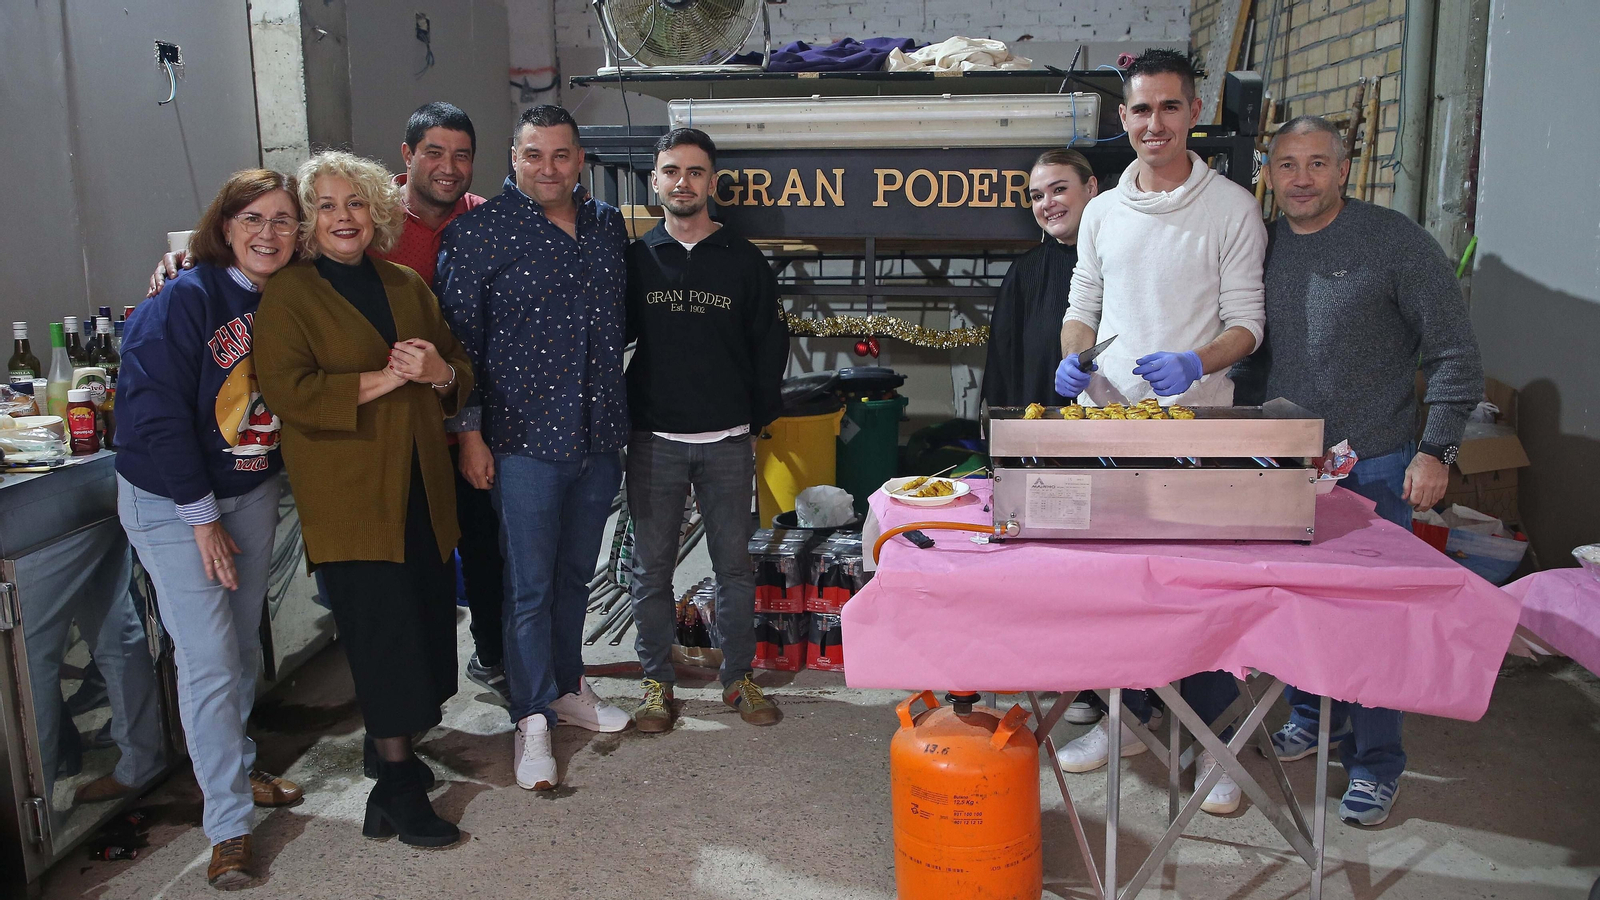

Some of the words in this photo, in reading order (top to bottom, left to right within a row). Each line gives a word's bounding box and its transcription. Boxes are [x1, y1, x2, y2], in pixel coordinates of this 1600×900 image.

[713, 168, 846, 207] GRAN
[872, 168, 1032, 208] PODER
[646, 290, 683, 304] GRAN
[689, 290, 732, 310] PODER
[671, 303, 685, 312] Est.
[690, 304, 706, 314] 1902
[924, 743, 951, 755] 13.6
